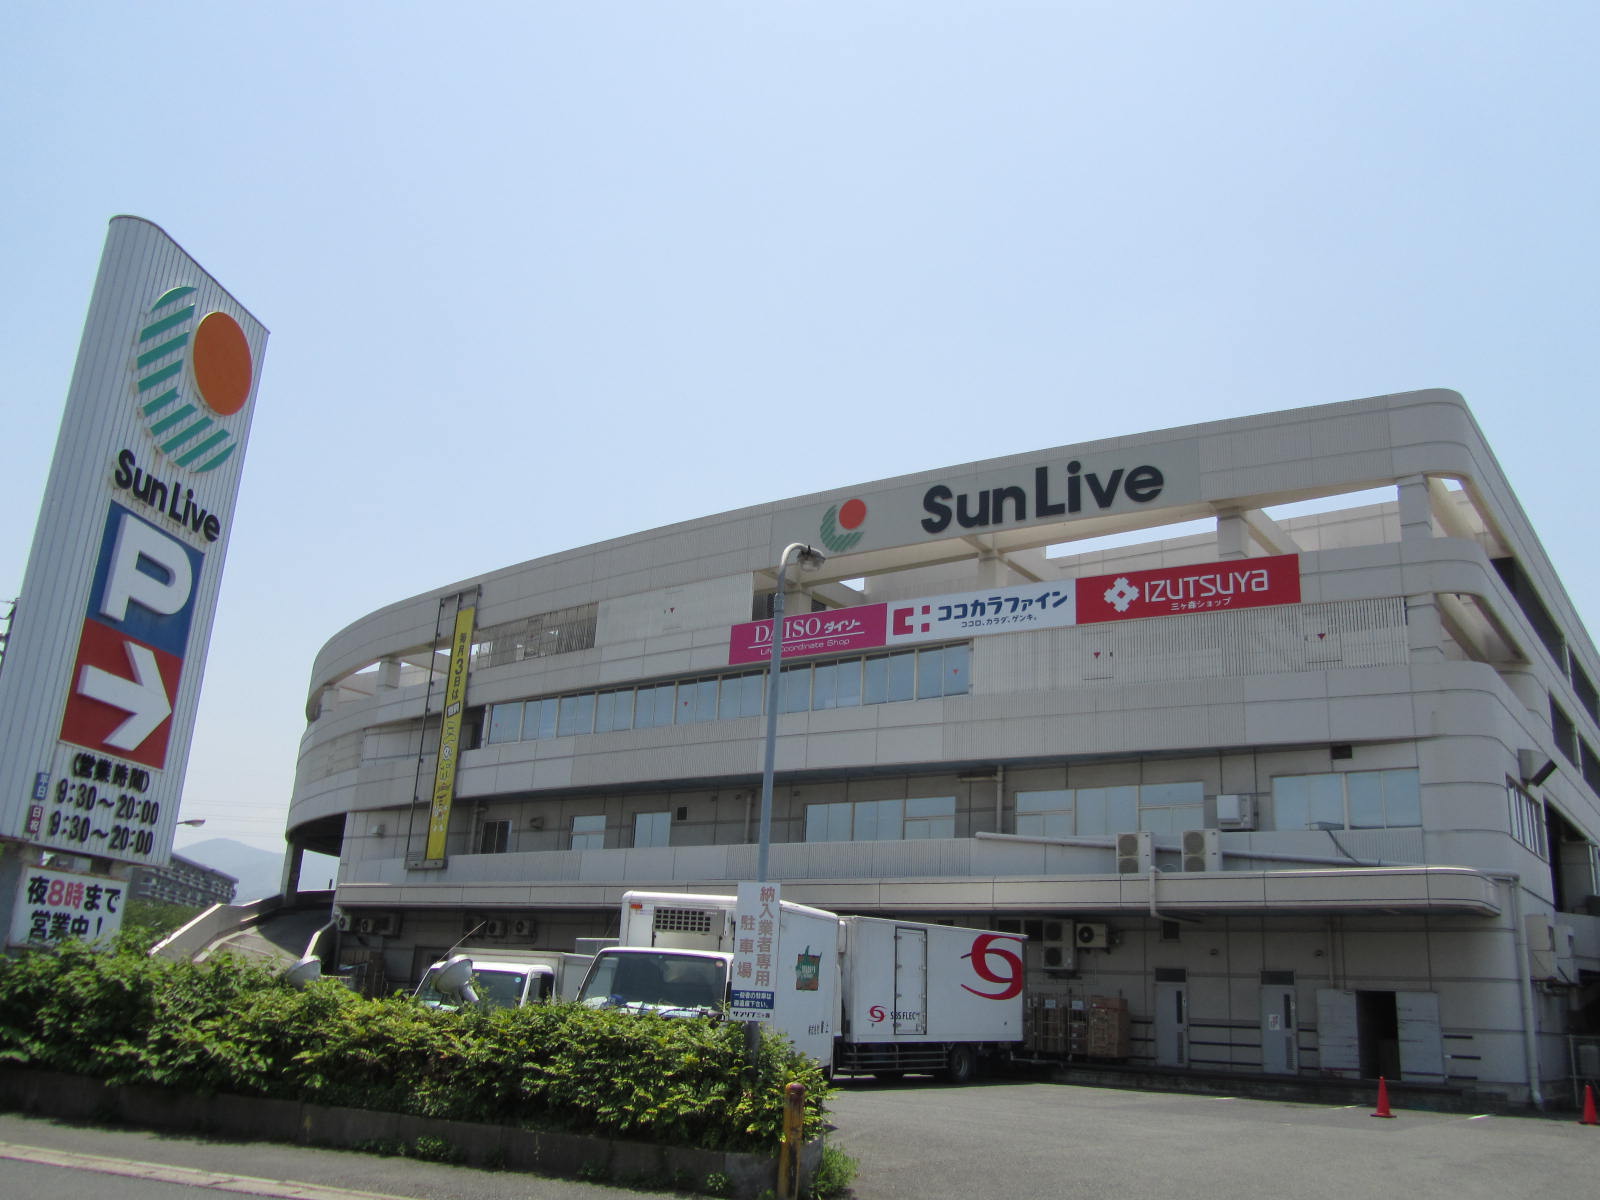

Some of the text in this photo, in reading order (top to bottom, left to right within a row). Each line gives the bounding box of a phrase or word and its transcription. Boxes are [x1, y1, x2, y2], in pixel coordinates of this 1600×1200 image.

[101, 512, 193, 623] P
[937, 591, 1068, 622] ココカラファイン
[754, 617, 861, 643] DISO ダイソー
[826, 638, 850, 647] Shop
[27, 876, 121, 913] 夜8時まで
[737, 914, 756, 979] 駐車場
[754, 886, 775, 986] 納入業者専用
